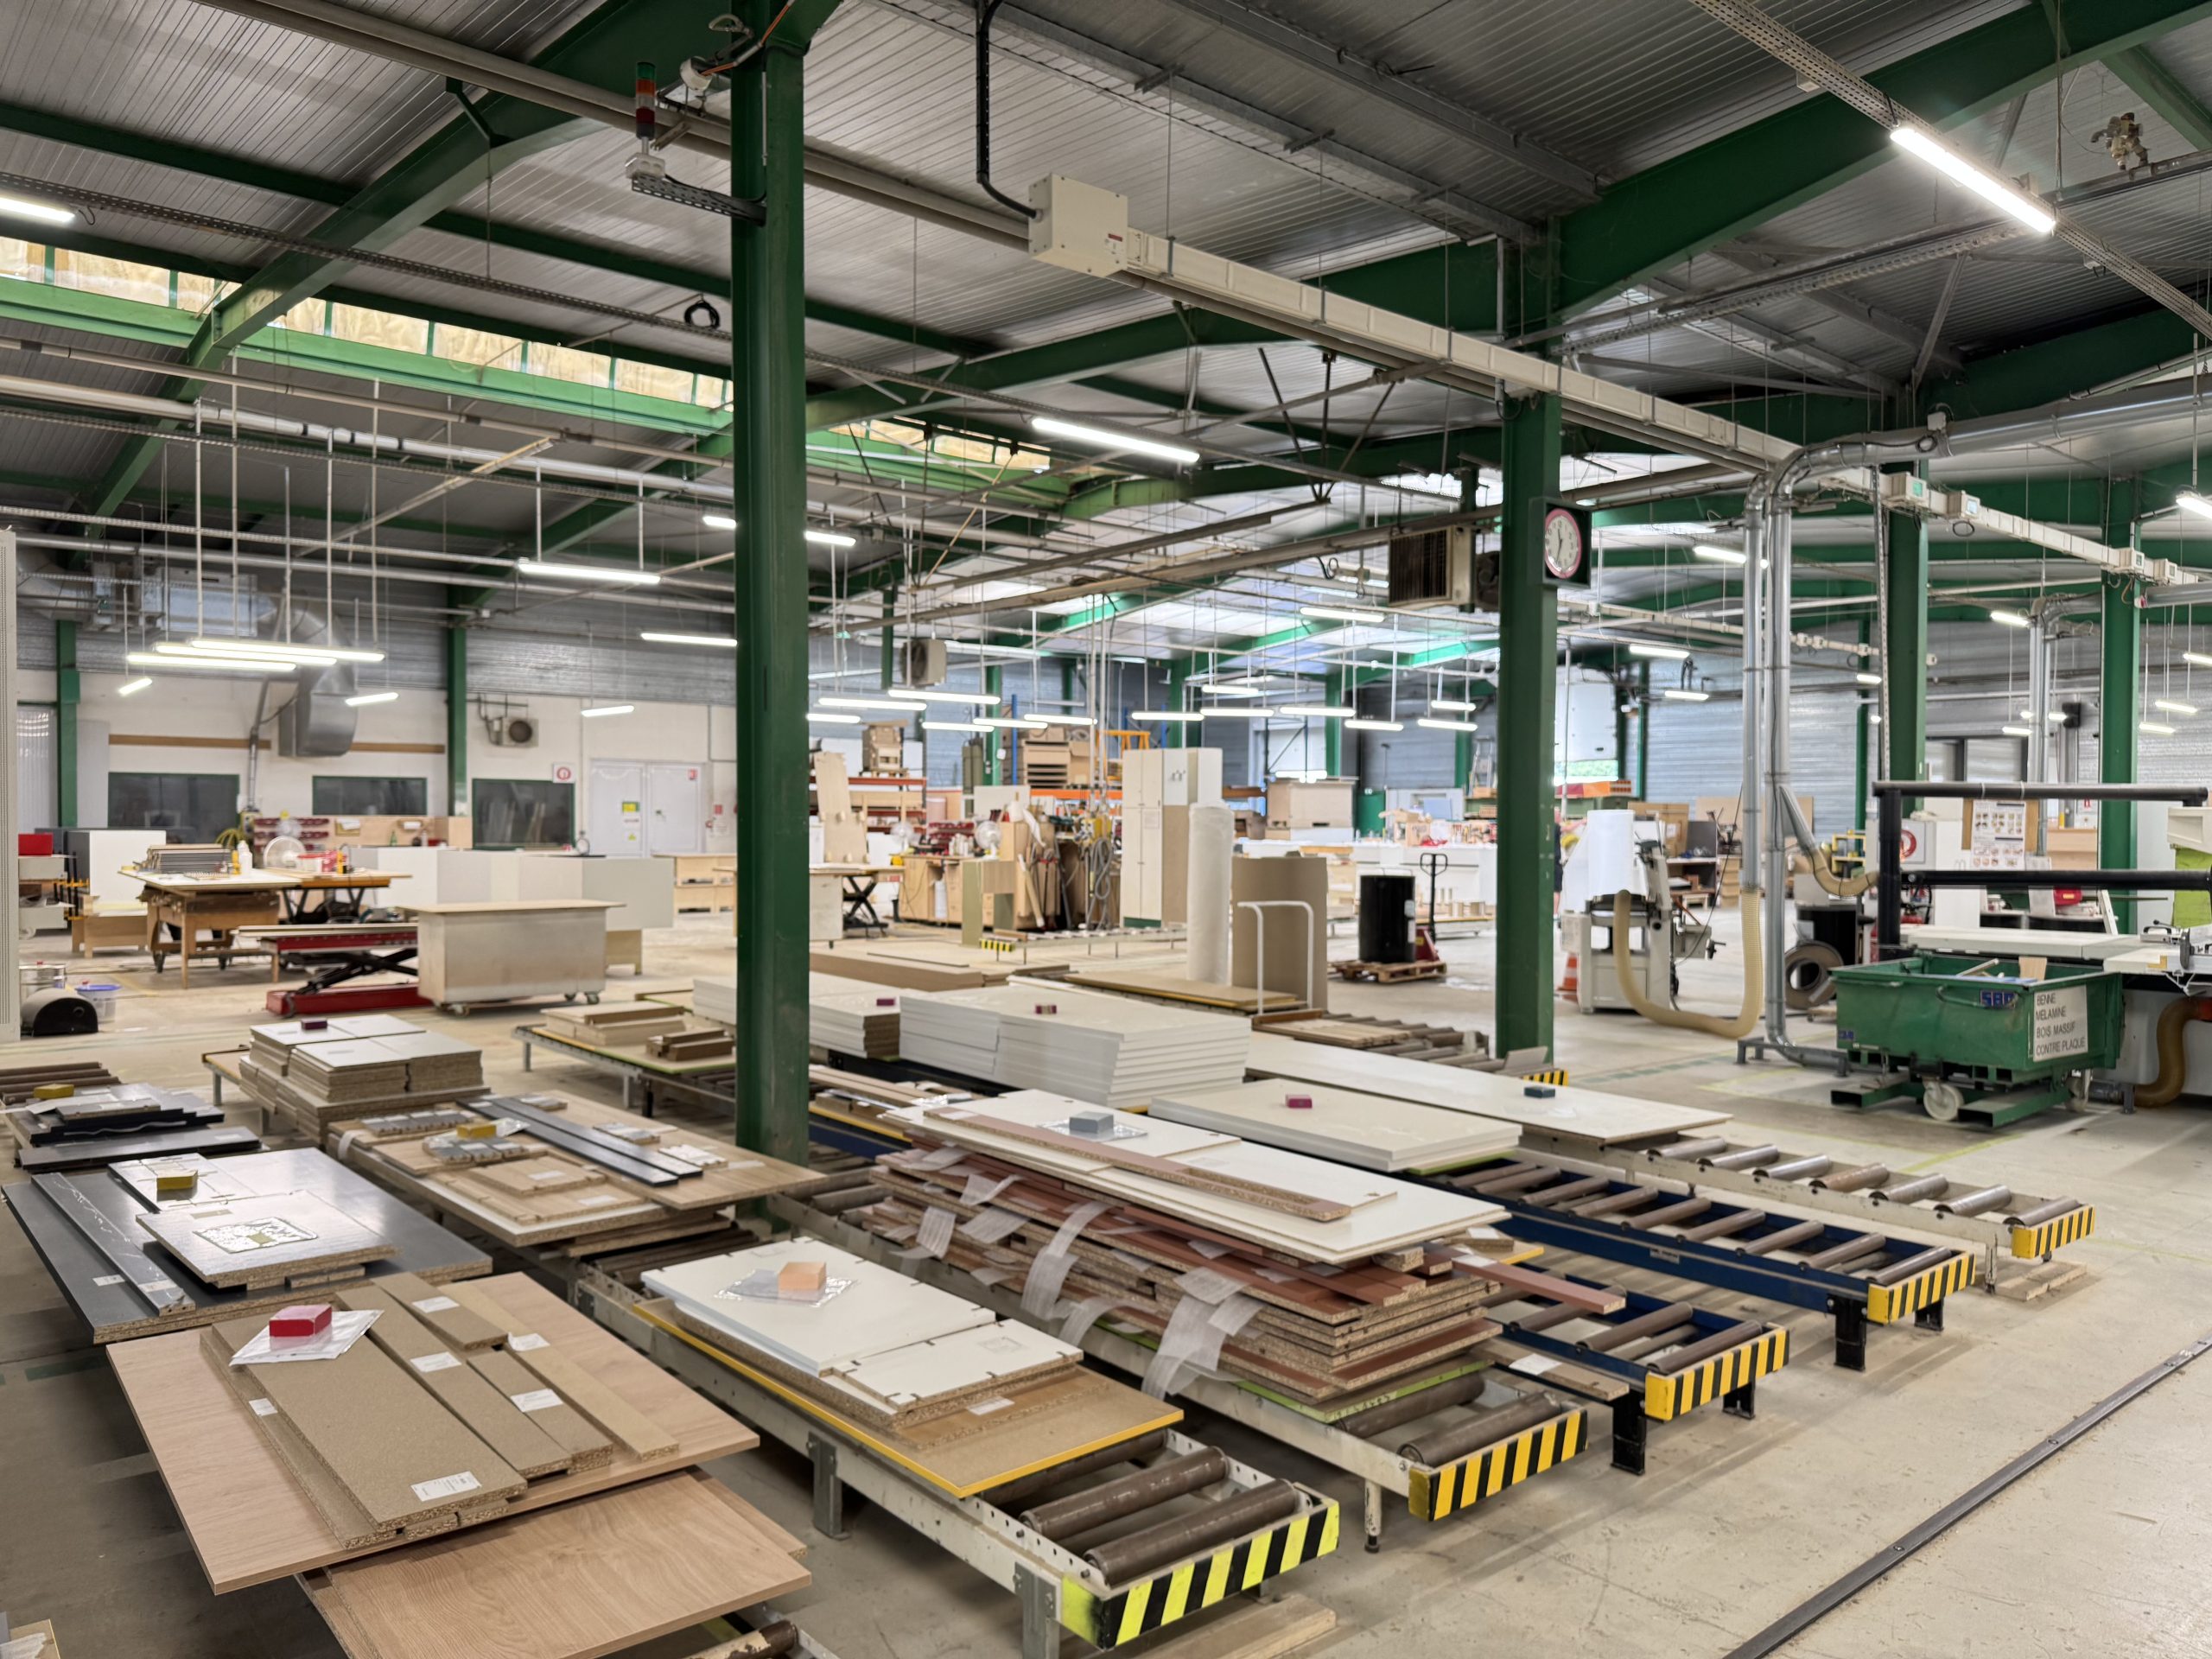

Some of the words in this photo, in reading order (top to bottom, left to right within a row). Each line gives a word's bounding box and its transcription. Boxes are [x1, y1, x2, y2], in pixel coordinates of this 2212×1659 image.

[2037, 992, 2056, 1006] BENNE
[2036, 1006, 2066, 1020] MELAMINE
[2036, 1026, 2051, 1038] BOIS
[2053, 1021, 2075, 1035] MASSIF
[2036, 1040, 2061, 1056] CONTRE
[2062, 1037, 2085, 1052] PLAQUE
